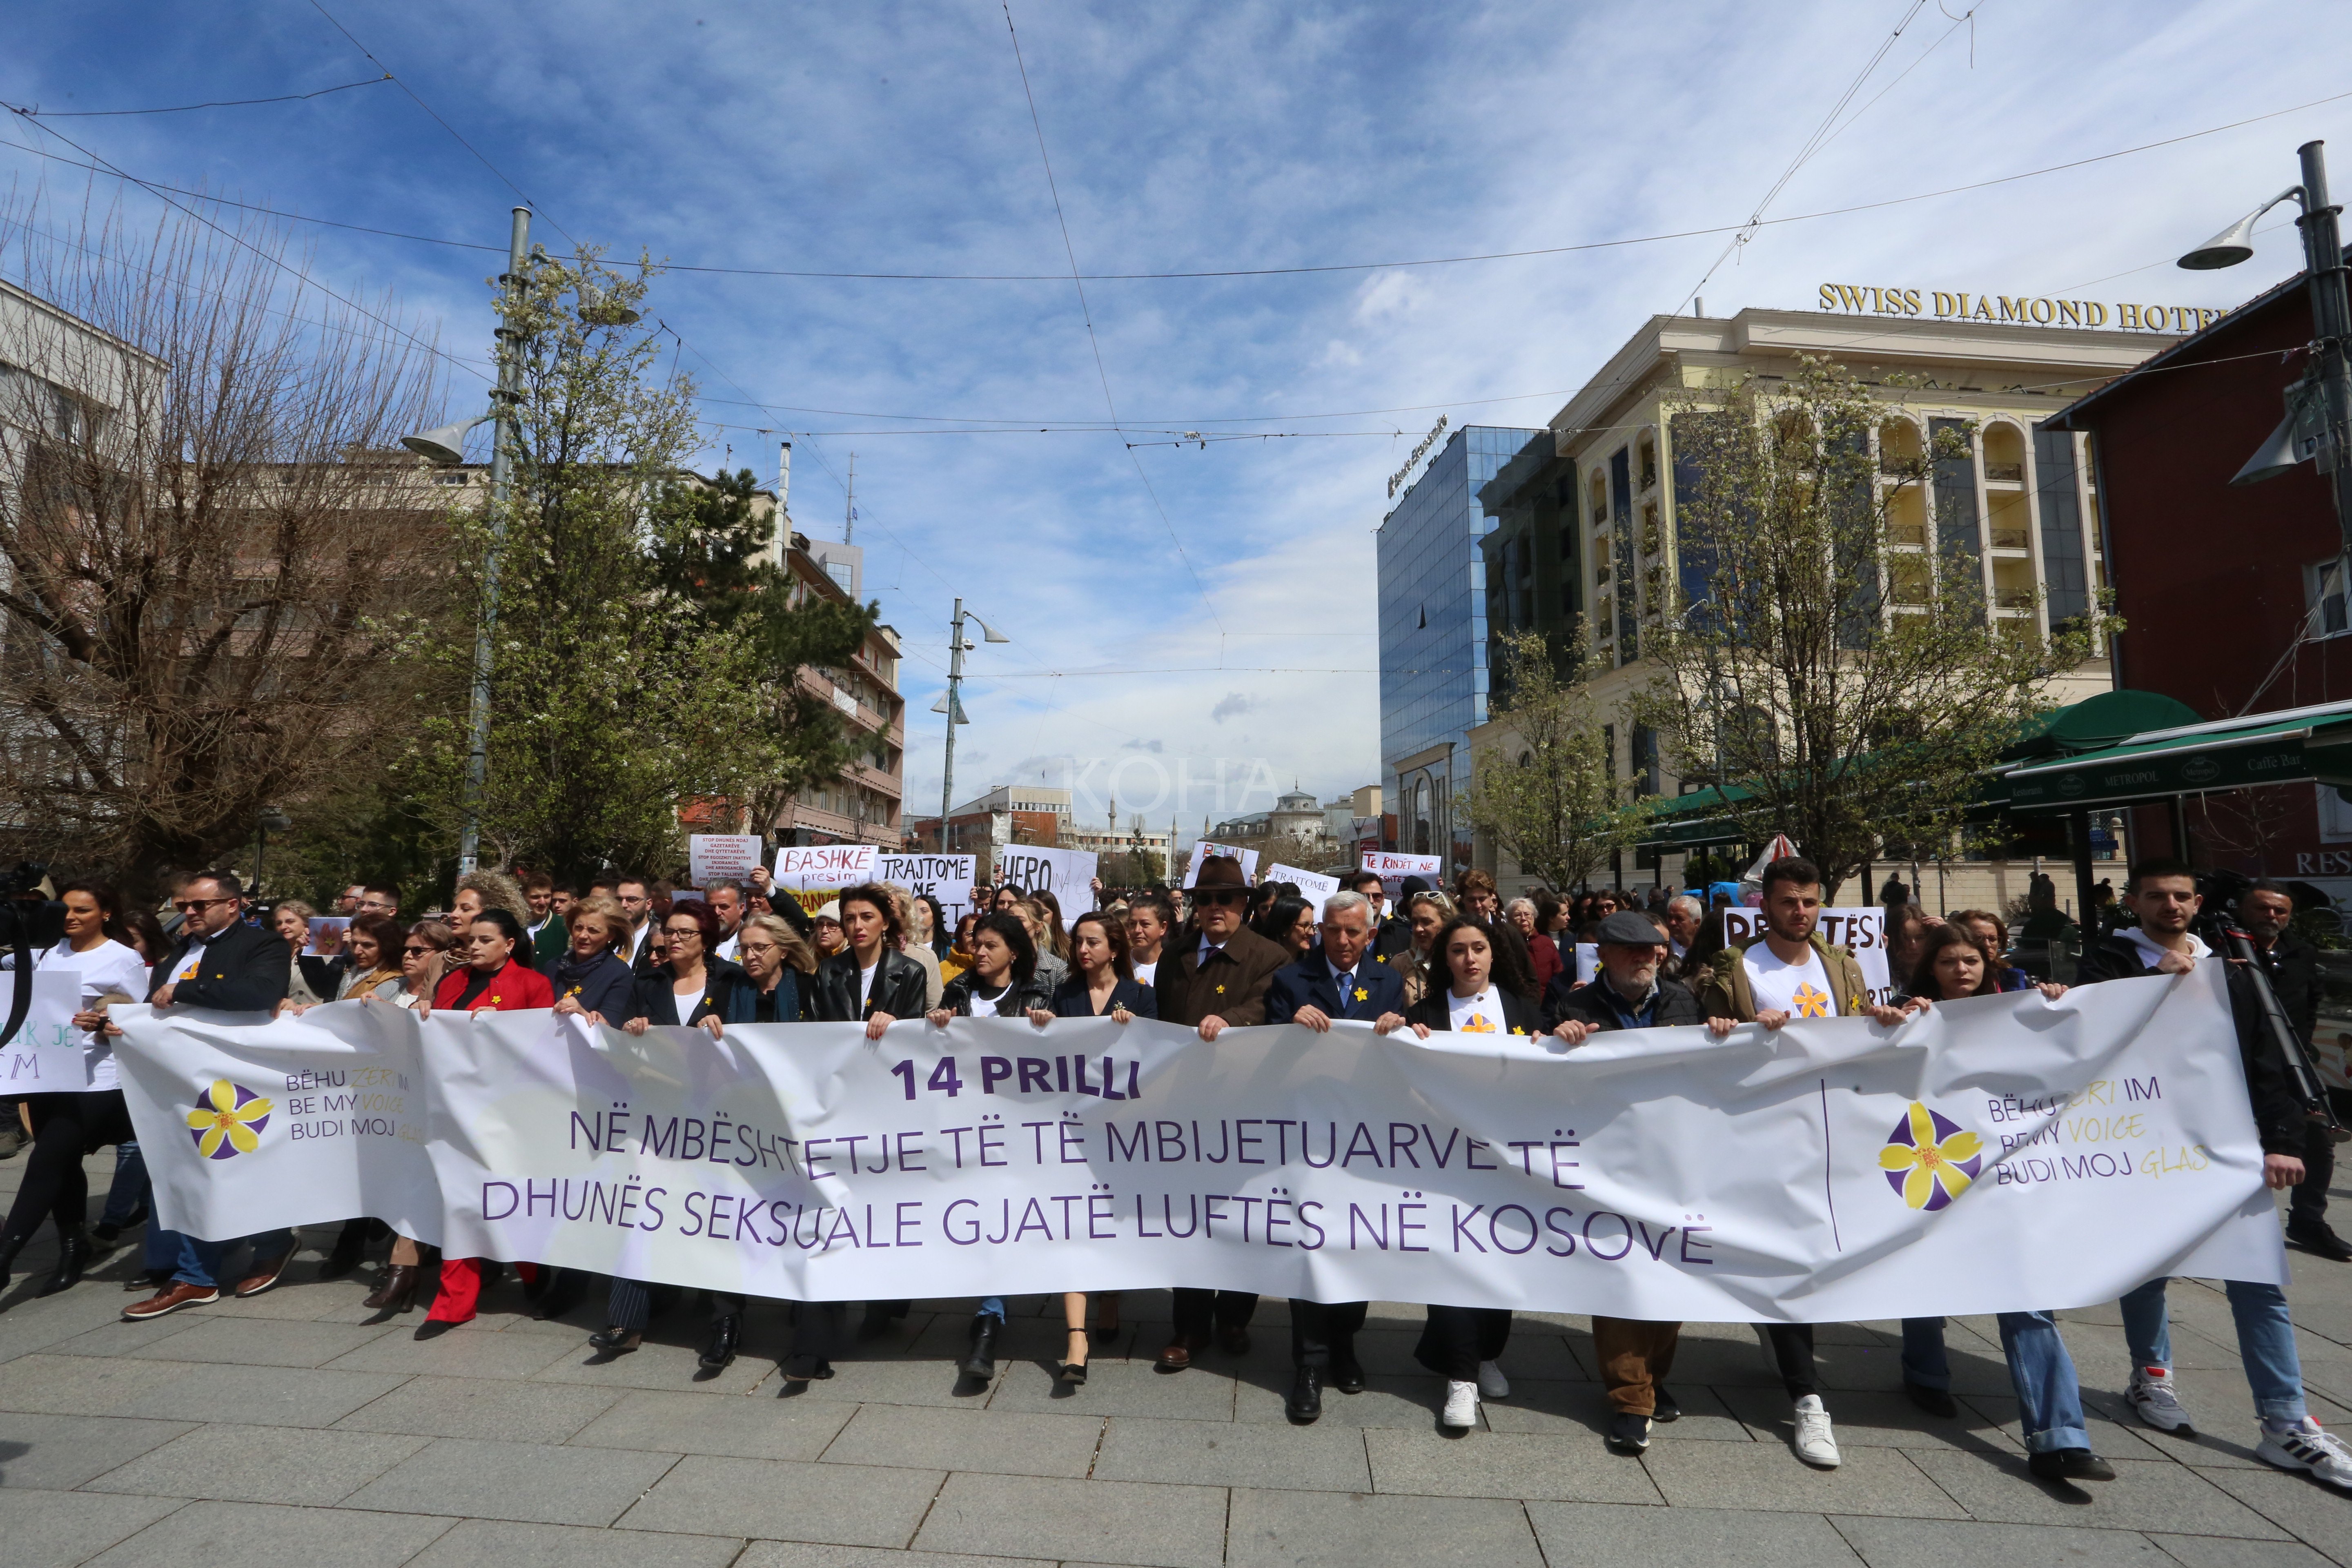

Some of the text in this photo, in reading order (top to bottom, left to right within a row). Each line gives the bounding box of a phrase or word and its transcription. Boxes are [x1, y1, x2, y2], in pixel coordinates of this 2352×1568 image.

[1819, 283, 2228, 332] SWISS DIAMOND HOTE
[2186, 766, 2215, 776] Metropol
[2279, 754, 2301, 766] Bar
[2104, 771, 2159, 787] METROPOL
[784, 846, 871, 873] BASHKË
[881, 858, 969, 881] TRAJTOMË
[1363, 854, 1377, 869] TË
[1419, 862, 1434, 871] NË
[801, 871, 857, 893] presim
[912, 882, 936, 898] ME
[1274, 871, 1329, 891] TRAJTOMË
[52, 1025, 74, 1047] JE
[286, 1069, 345, 1092] BËHU
[350, 1065, 396, 1089] ZËRI
[891, 1055, 1141, 1101] 14 PRILLI
[289, 1092, 405, 1116] BE MY VOICE
[1988, 1093, 2057, 1123] BËHU
[2124, 1076, 2161, 1102] IM
[291, 1119, 343, 1140] BUDI
[352, 1118, 395, 1136] MOJ
[2067, 1113, 2147, 1143] VOICE
[571, 1102, 1585, 1190] NË MBËSHTETJE TË TË MBIJETUARVE TË
[1995, 1145, 2209, 1185] BUDI MOJ GLAS
[483, 1175, 1713, 1264] DHUNËS SEKSUALE GJATË LUFTËS NË KOSOVË
